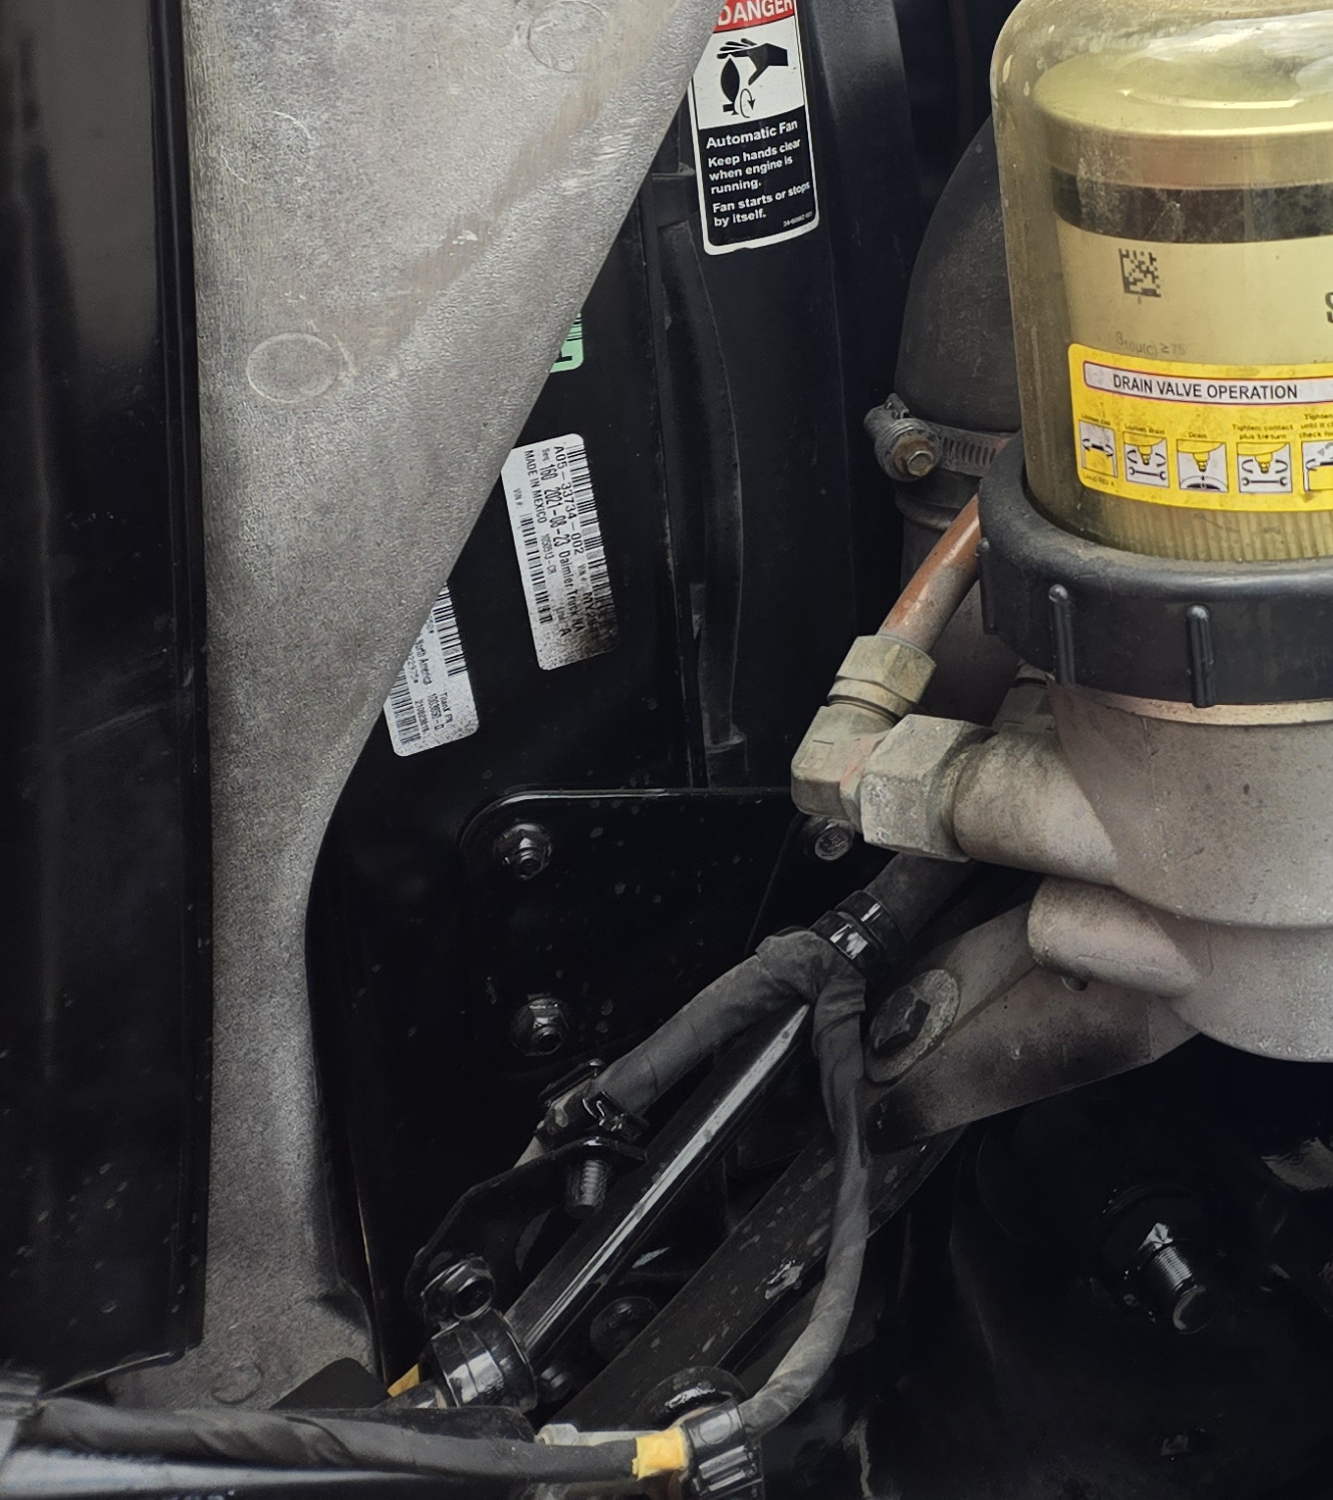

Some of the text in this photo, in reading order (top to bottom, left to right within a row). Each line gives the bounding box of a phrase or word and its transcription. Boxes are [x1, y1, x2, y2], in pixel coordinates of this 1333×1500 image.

[706, 118, 799, 150] Automatic Fan
[708, 138, 802, 169] Keep hands clear
[709, 155, 794, 182] when engine is
[711, 179, 762, 195] running.
[712, 180, 811, 214] Fan starts or stops
[714, 213, 730, 229] by
[732, 208, 767, 225] itself.
[1113, 373, 1298, 400] DRAIN VALVE OPERATION
[1299, 431, 1322, 439] check
[1300, 422, 1318, 430] until
[524, 449, 538, 477] MADE
[531, 489, 547, 524] MEXICO
[553, 444, 585, 556] A05-33734-002
[543, 486, 571, 548] 2021-08-23
[558, 550, 576, 588] Daimler
[565, 589, 582, 617] Truck
[418, 658, 433, 686] America
